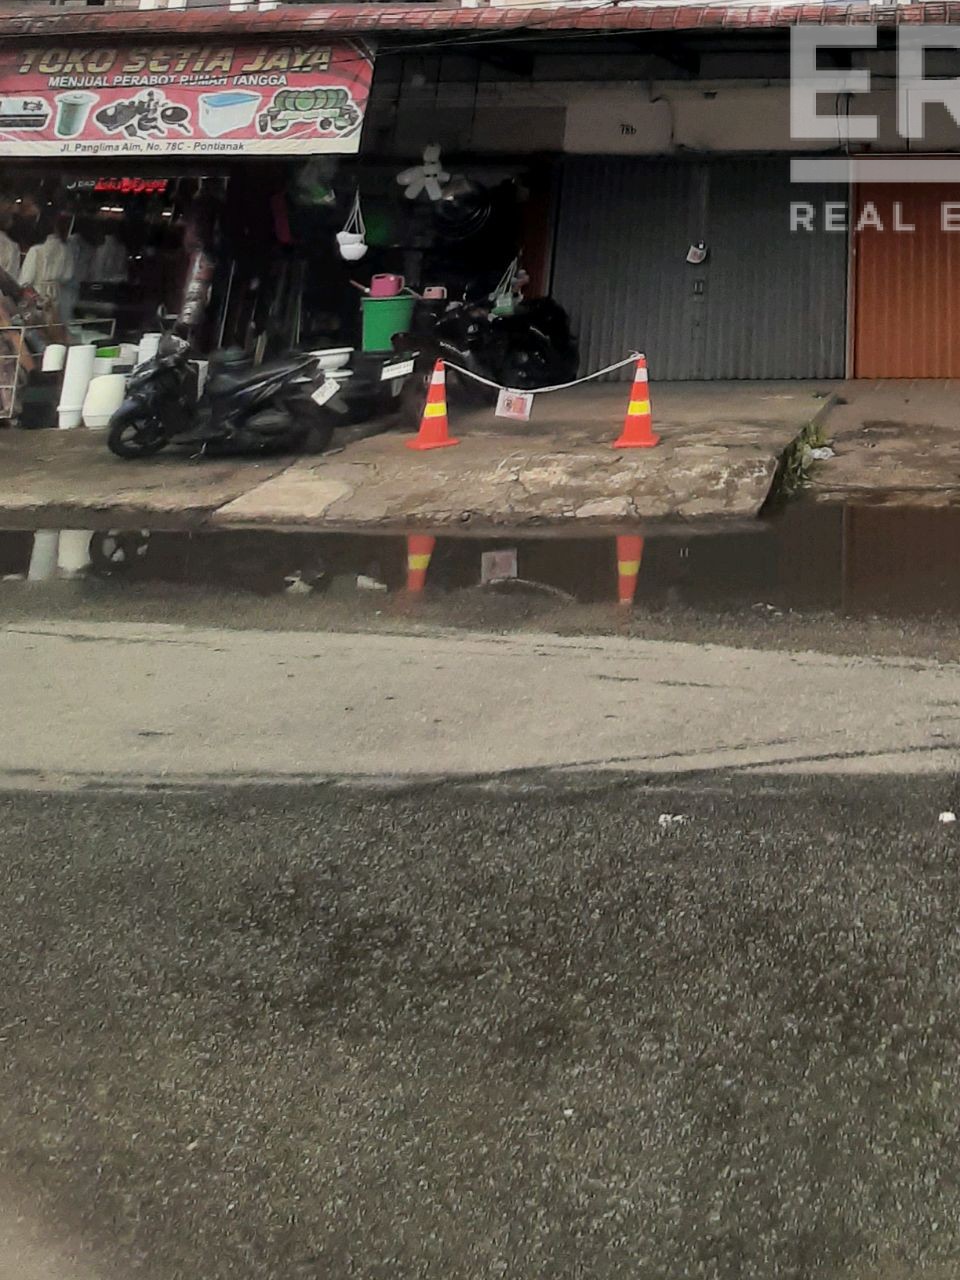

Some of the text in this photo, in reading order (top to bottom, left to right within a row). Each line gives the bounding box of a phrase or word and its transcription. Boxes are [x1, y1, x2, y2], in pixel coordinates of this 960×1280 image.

[19, 47, 117, 73] TOKO
[241, 46, 332, 72] JAYA
[48, 76, 110, 87] MENJUAL
[112, 75, 176, 86] PERABOT
[232, 74, 287, 85] TANGGA
[74, 143, 120, 154] Panglima
[146, 143, 163, 152] No.
[193, 142, 245, 151] Pontianak
